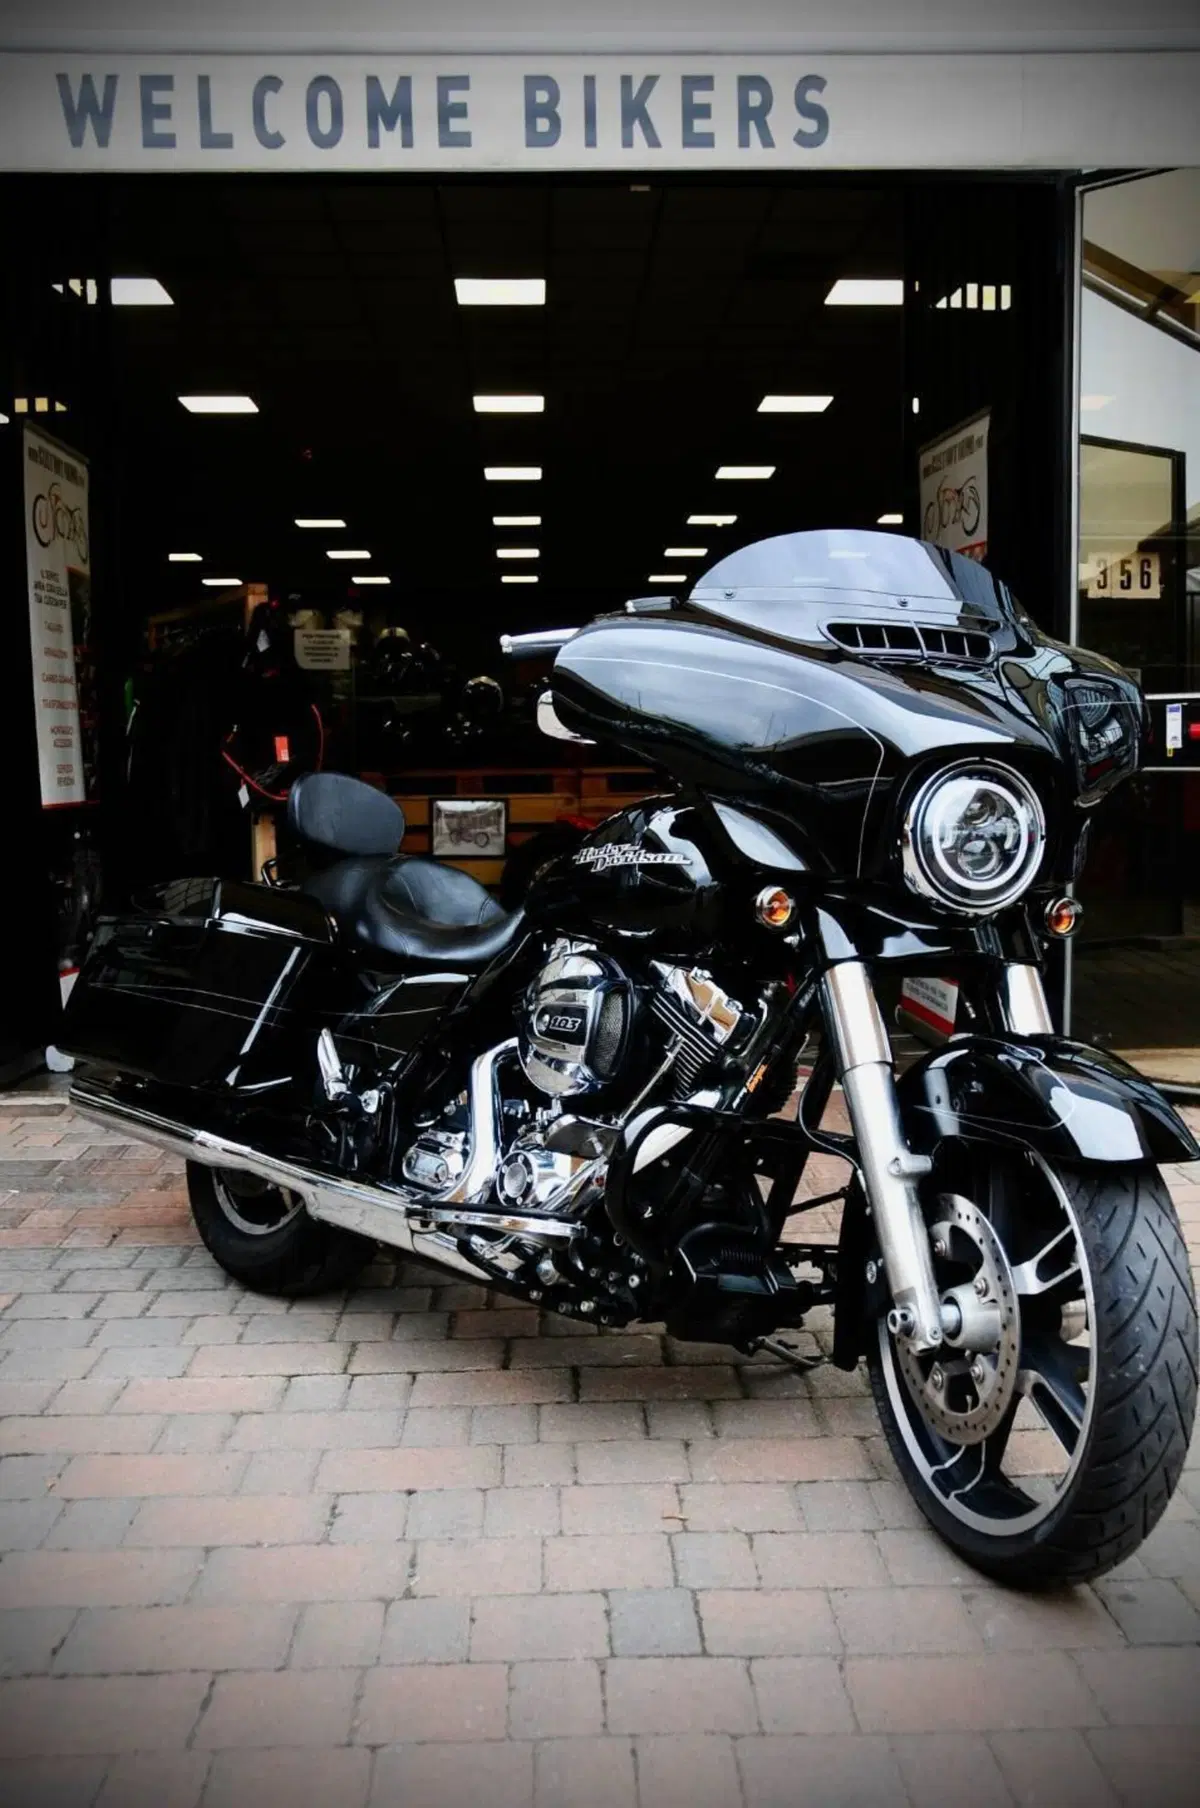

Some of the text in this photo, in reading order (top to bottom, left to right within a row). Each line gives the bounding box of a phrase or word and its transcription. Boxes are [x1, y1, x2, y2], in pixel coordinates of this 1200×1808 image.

[56, 73, 832, 149] WELCOME BIKERS
[1096, 558, 1151, 590] 356
[550, 1015, 582, 1032] 103
